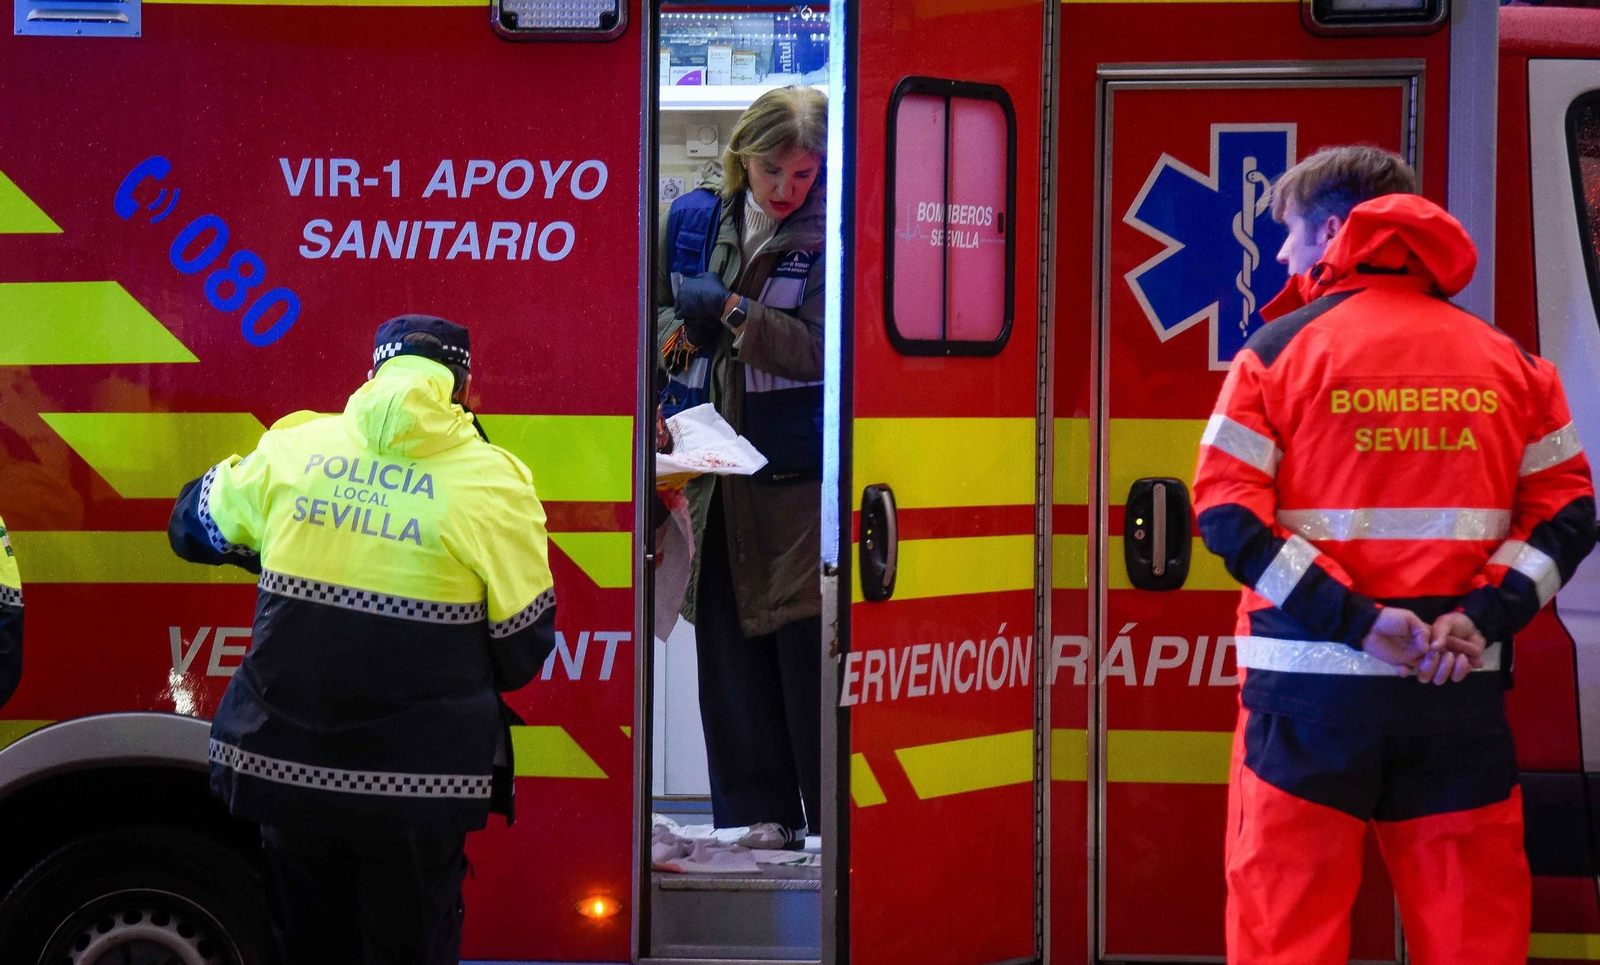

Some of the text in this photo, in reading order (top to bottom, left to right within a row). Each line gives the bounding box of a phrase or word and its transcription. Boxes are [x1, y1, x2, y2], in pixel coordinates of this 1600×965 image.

[279, 157, 608, 200] VIR-1 APOYO
[917, 202, 993, 226] BOMBEROS
[299, 219, 576, 262] SANITARIO
[930, 228, 979, 249] SEVILLA
[168, 213, 301, 348] 080
[1330, 387, 1499, 414] BOMBEROS
[1354, 427, 1478, 452] SEVILLA
[303, 453, 435, 500] POLICÍA
[333, 484, 390, 508] LOCAL
[292, 495, 423, 546] SEVILLA
[168, 626, 253, 677] VE
[540, 631, 632, 681] NT
[1045, 622, 1240, 687] RÁPID
